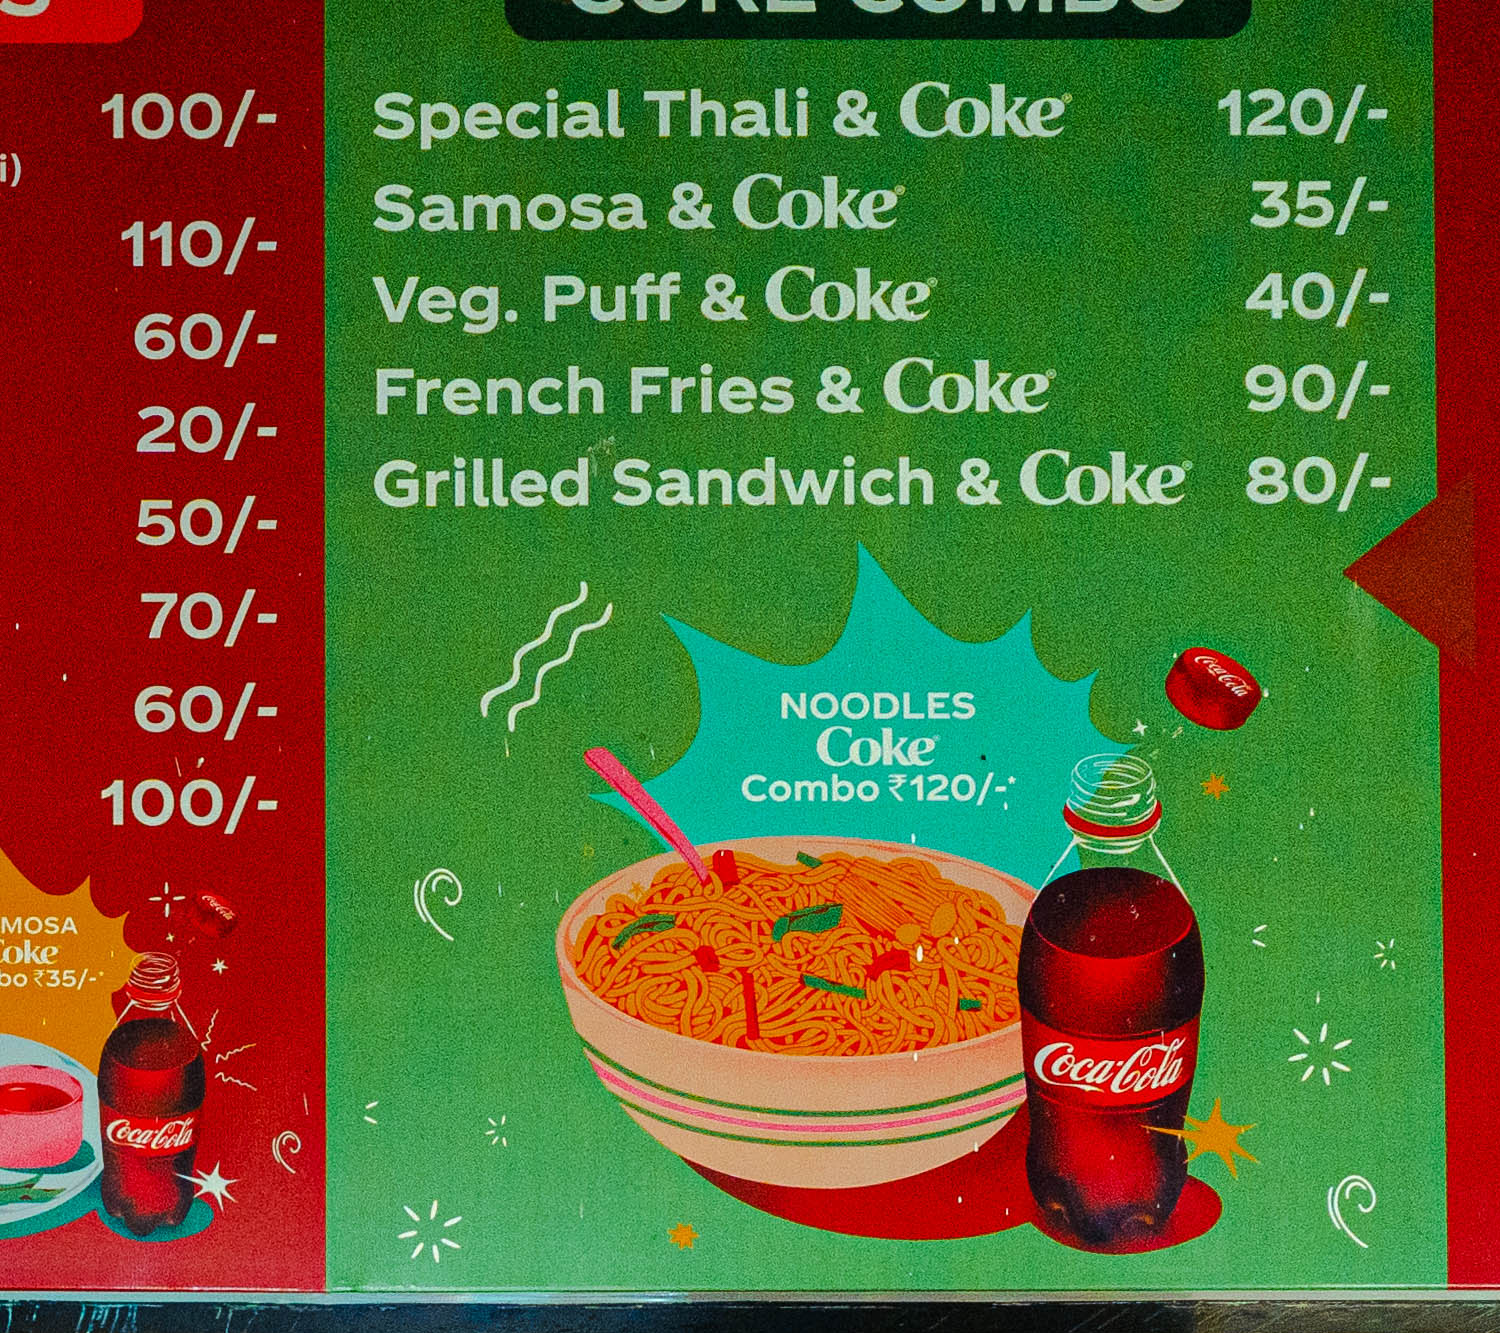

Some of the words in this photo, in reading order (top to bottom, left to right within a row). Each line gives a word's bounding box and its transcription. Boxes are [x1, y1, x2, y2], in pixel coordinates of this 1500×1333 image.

[102, 89, 276, 147] 100/-
[374, 89, 624, 150] Special
[644, 87, 808, 137] Thali
[833, 89, 879, 137] &
[900, 82, 1065, 138] Coke
[1218, 84, 1388, 143] 120/-
[374, 184, 647, 232] Samosa
[668, 182, 714, 230] &
[733, 173, 897, 230] Coke
[1251, 177, 1388, 235] 35/-
[121, 217, 277, 275] 110/-
[373, 277, 517, 333] Veg.
[545, 272, 680, 322] Puff
[701, 273, 746, 321] &
[765, 266, 929, 322] Coke
[1246, 269, 1389, 327] 40/-
[134, 310, 276, 368] 60/-
[376, 366, 604, 415] French
[631, 364, 794, 414] Fries
[816, 366, 862, 413] &
[883, 357, 1055, 413] Coke
[1245, 361, 1389, 419] 90/-
[137, 403, 277, 460] 20/-
[374, 457, 588, 507] Grilled
[613, 456, 933, 506] Sandwich
[957, 458, 1000, 505] &
[1020, 449, 1185, 505] Coke
[1246, 453, 1390, 512] 80/-
[137, 496, 277, 553] 50/-
[141, 589, 277, 647] 70/-
[134, 682, 277, 740] 60/-
[781, 692, 975, 719] NOODLES
[816, 726, 939, 766] Coke
[101, 776, 277, 834] 100/-
[741, 774, 879, 802] Combo
[1034, 1036, 1187, 1094] Coca-Cola
[106, 1117, 193, 1150] Coca-Cola
